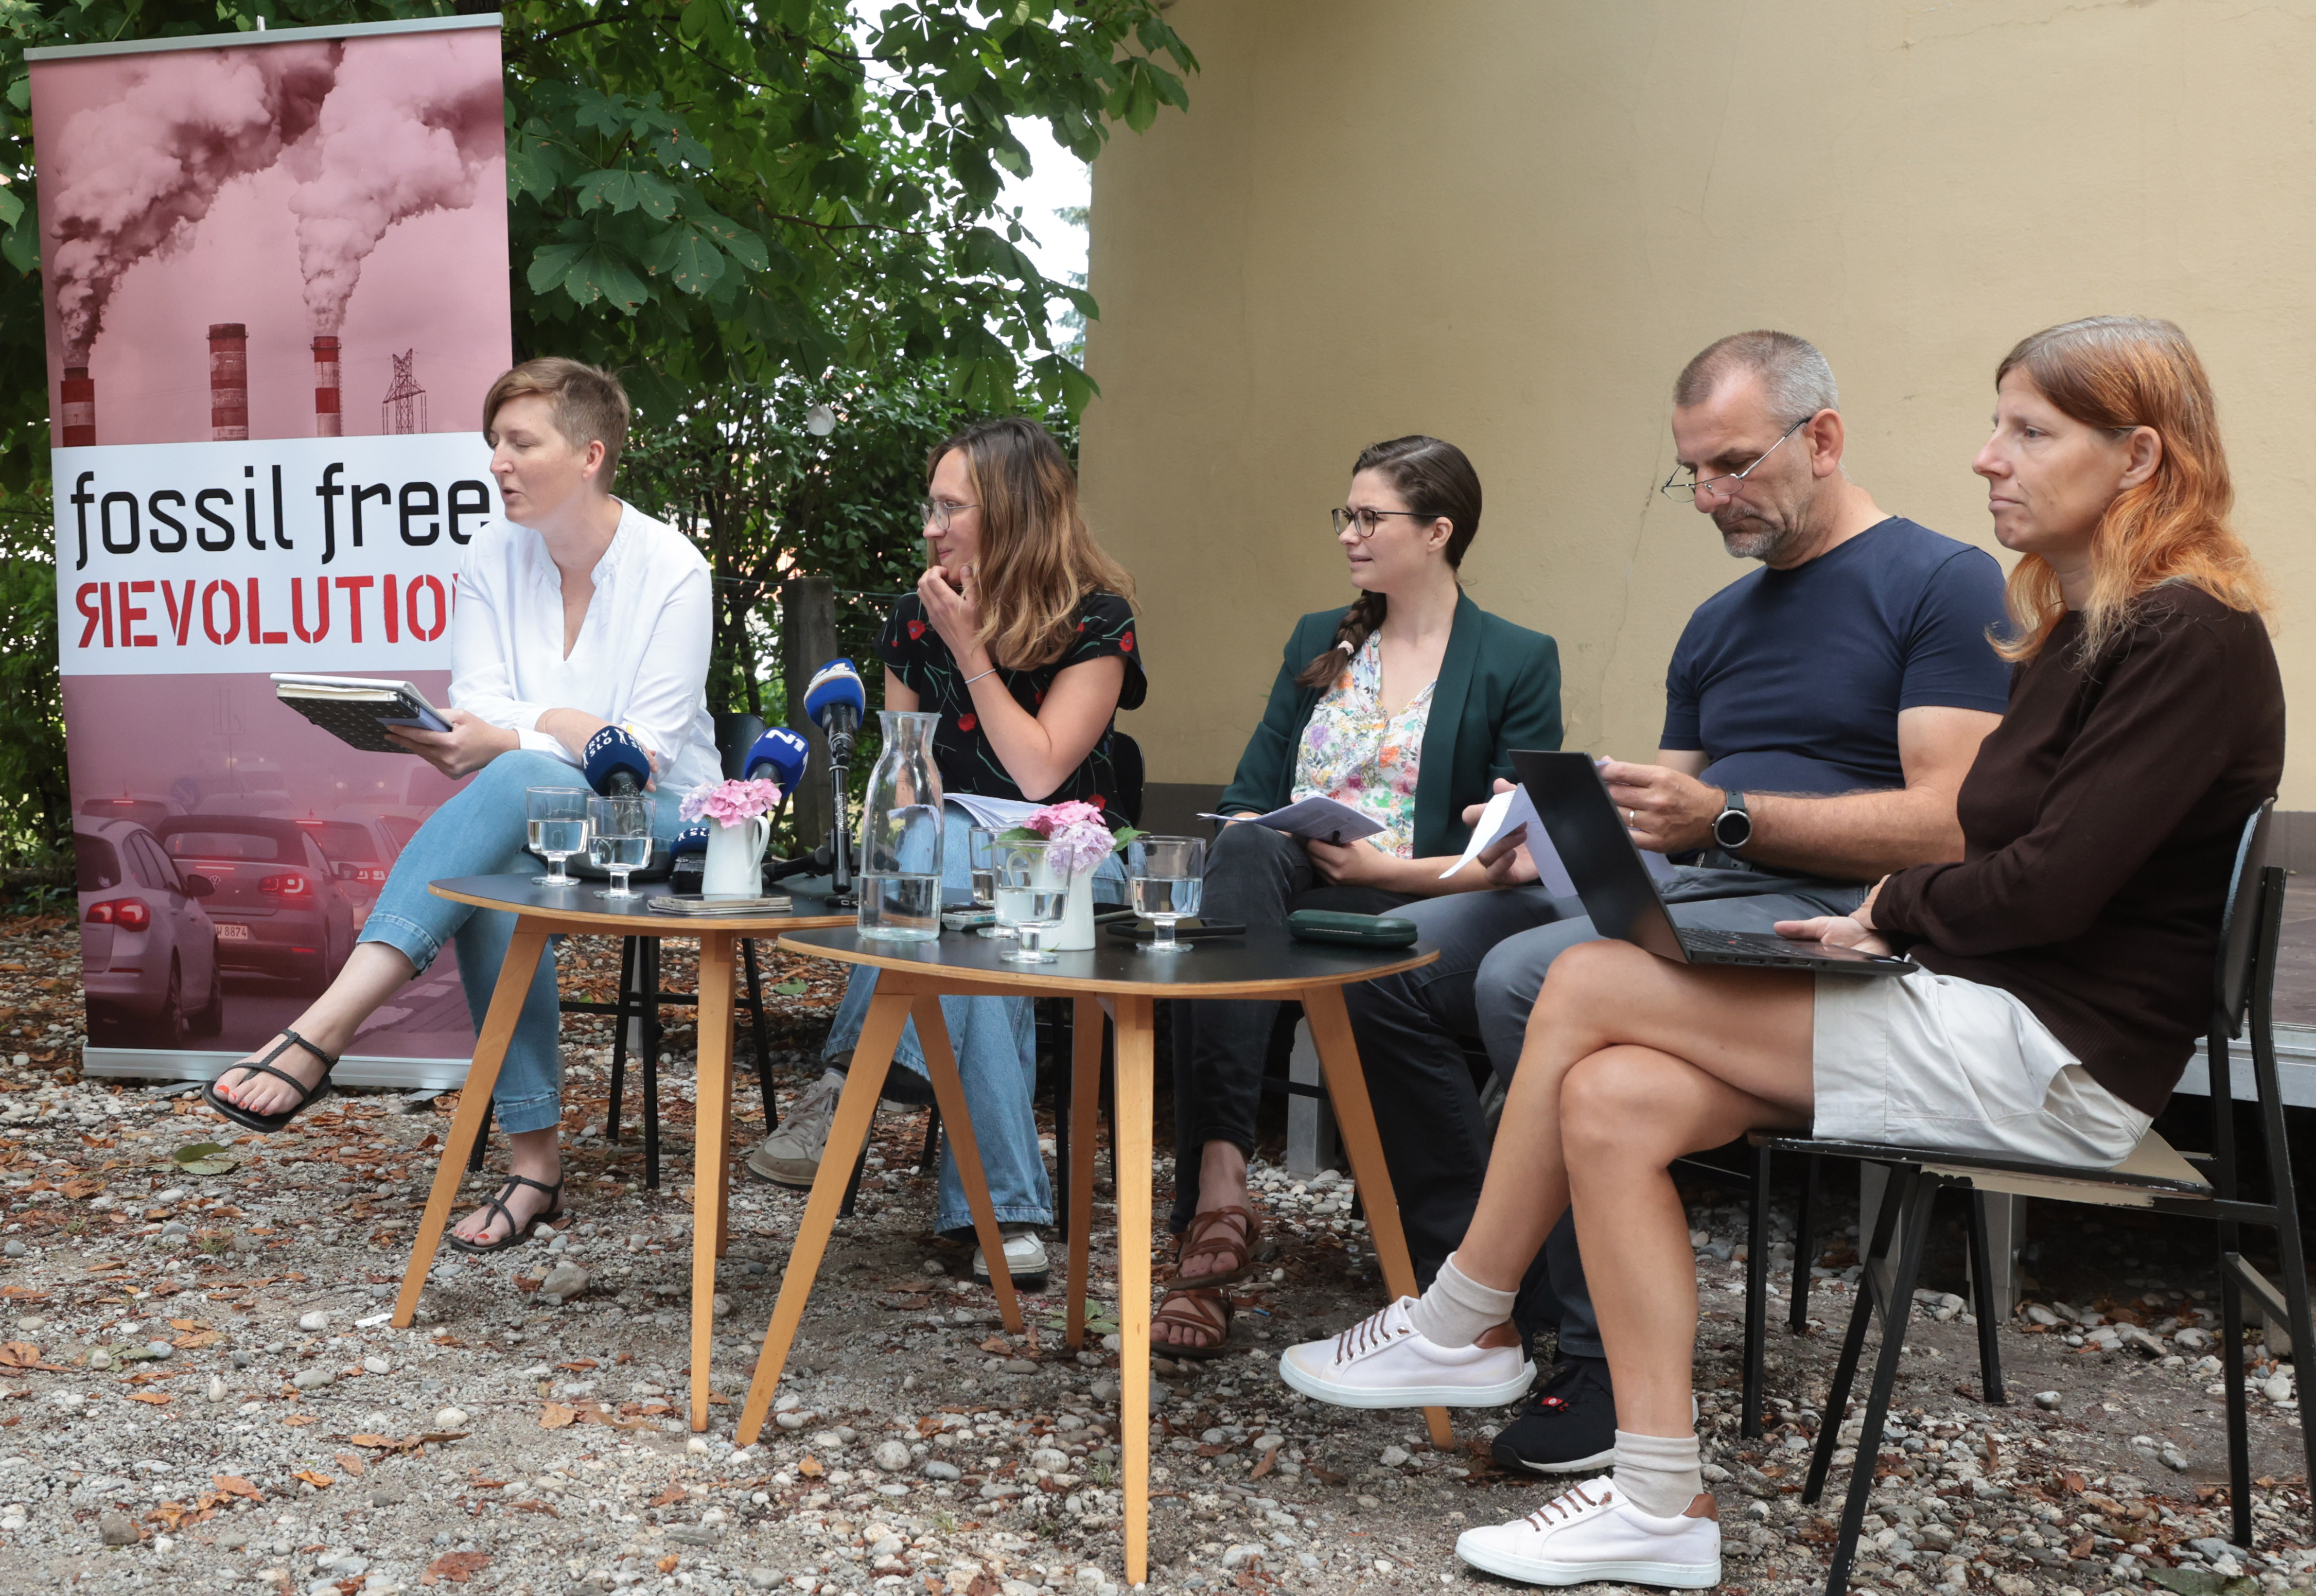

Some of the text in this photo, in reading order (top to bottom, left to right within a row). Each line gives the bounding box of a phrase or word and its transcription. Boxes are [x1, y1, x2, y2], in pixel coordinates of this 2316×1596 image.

[71, 462, 490, 571] fossil free
[76, 573, 458, 648] REVOLUTIO
[588, 730, 610, 750] RTV
[589, 737, 612, 757] SLO
[765, 729, 805, 752] N1
[224, 926, 247, 937] 8874
